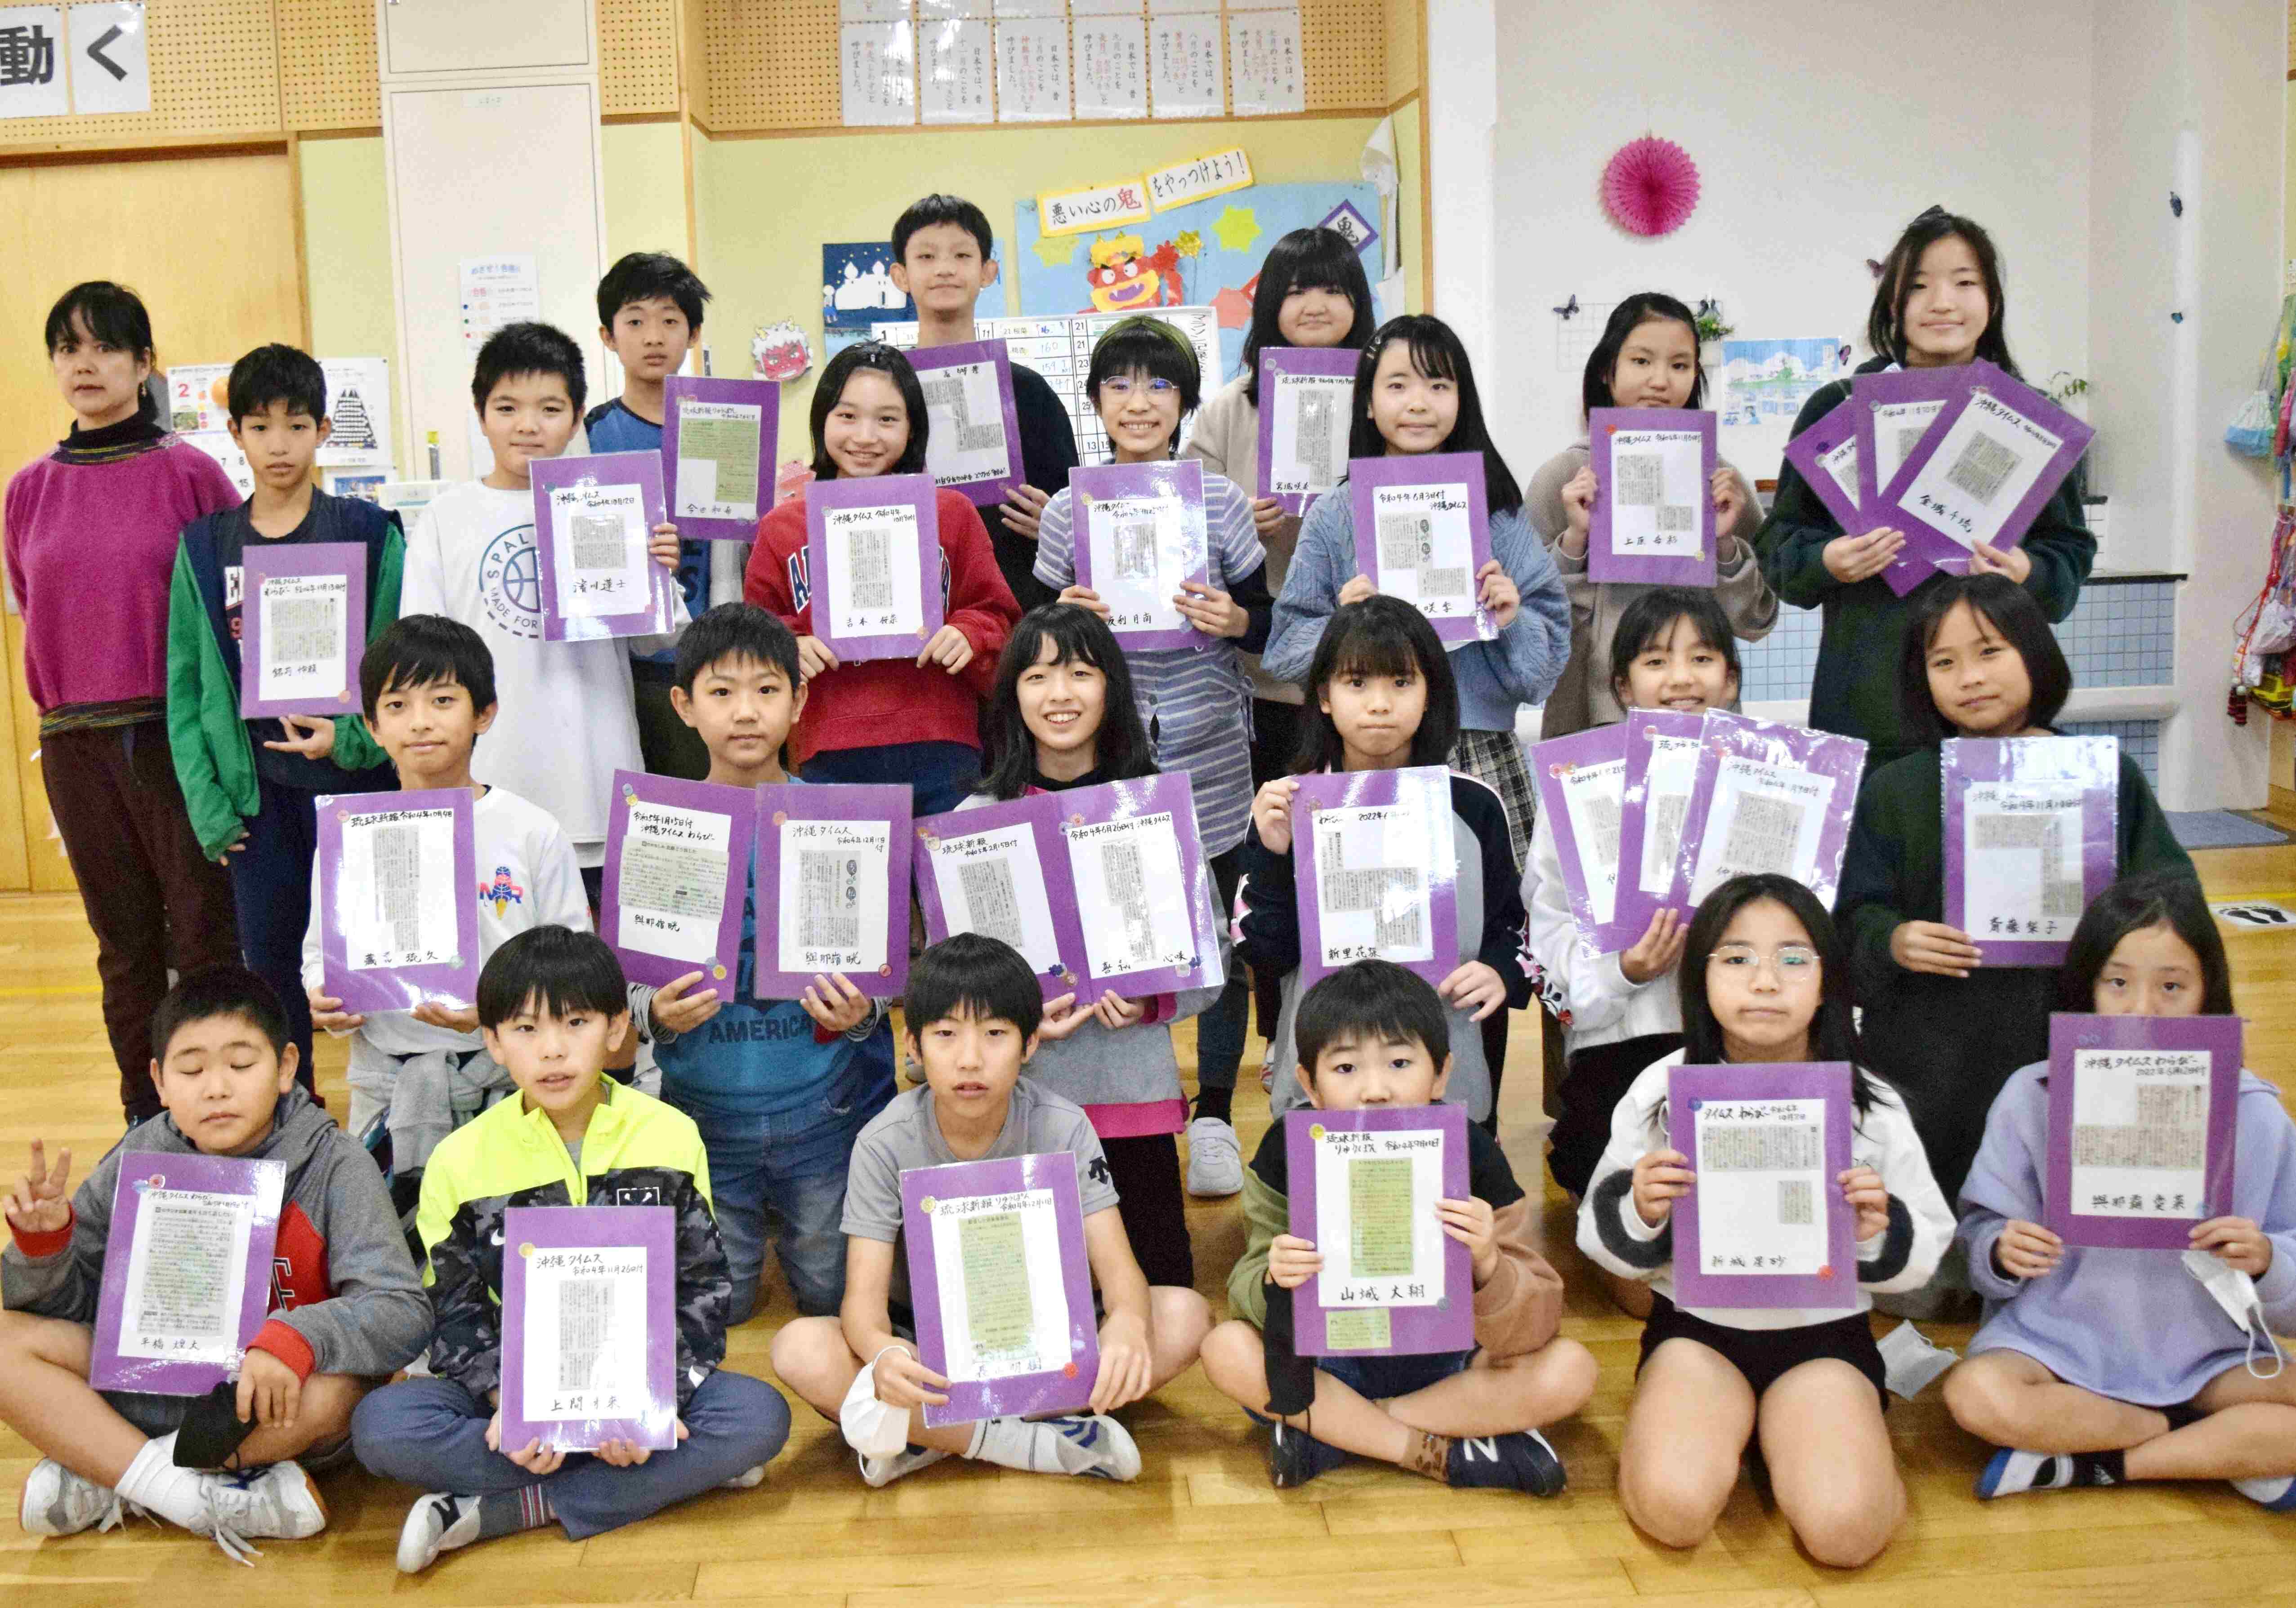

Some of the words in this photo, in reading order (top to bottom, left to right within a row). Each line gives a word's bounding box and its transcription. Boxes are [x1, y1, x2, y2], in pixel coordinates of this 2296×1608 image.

[1051, 187, 1143, 226] 悪い心の鬼
[1337, 216, 1360, 245] 鬼
[1075, 322, 1084, 330] 21
[1077, 340, 1085, 348] 21
[1079, 359, 1089, 368] 23
[178, 384, 189, 398] 2
[1087, 442, 1096, 450] 13
[833, 512, 874, 525] 沖縄タイムス
[514, 615, 538, 630] FOR
[640, 825, 684, 838] 沖縄タイムス
[942, 837, 989, 855] 琉球新報
[536, 1253, 604, 1269] 沖縄タイムス
[1341, 1286, 1380, 1302] 山城
